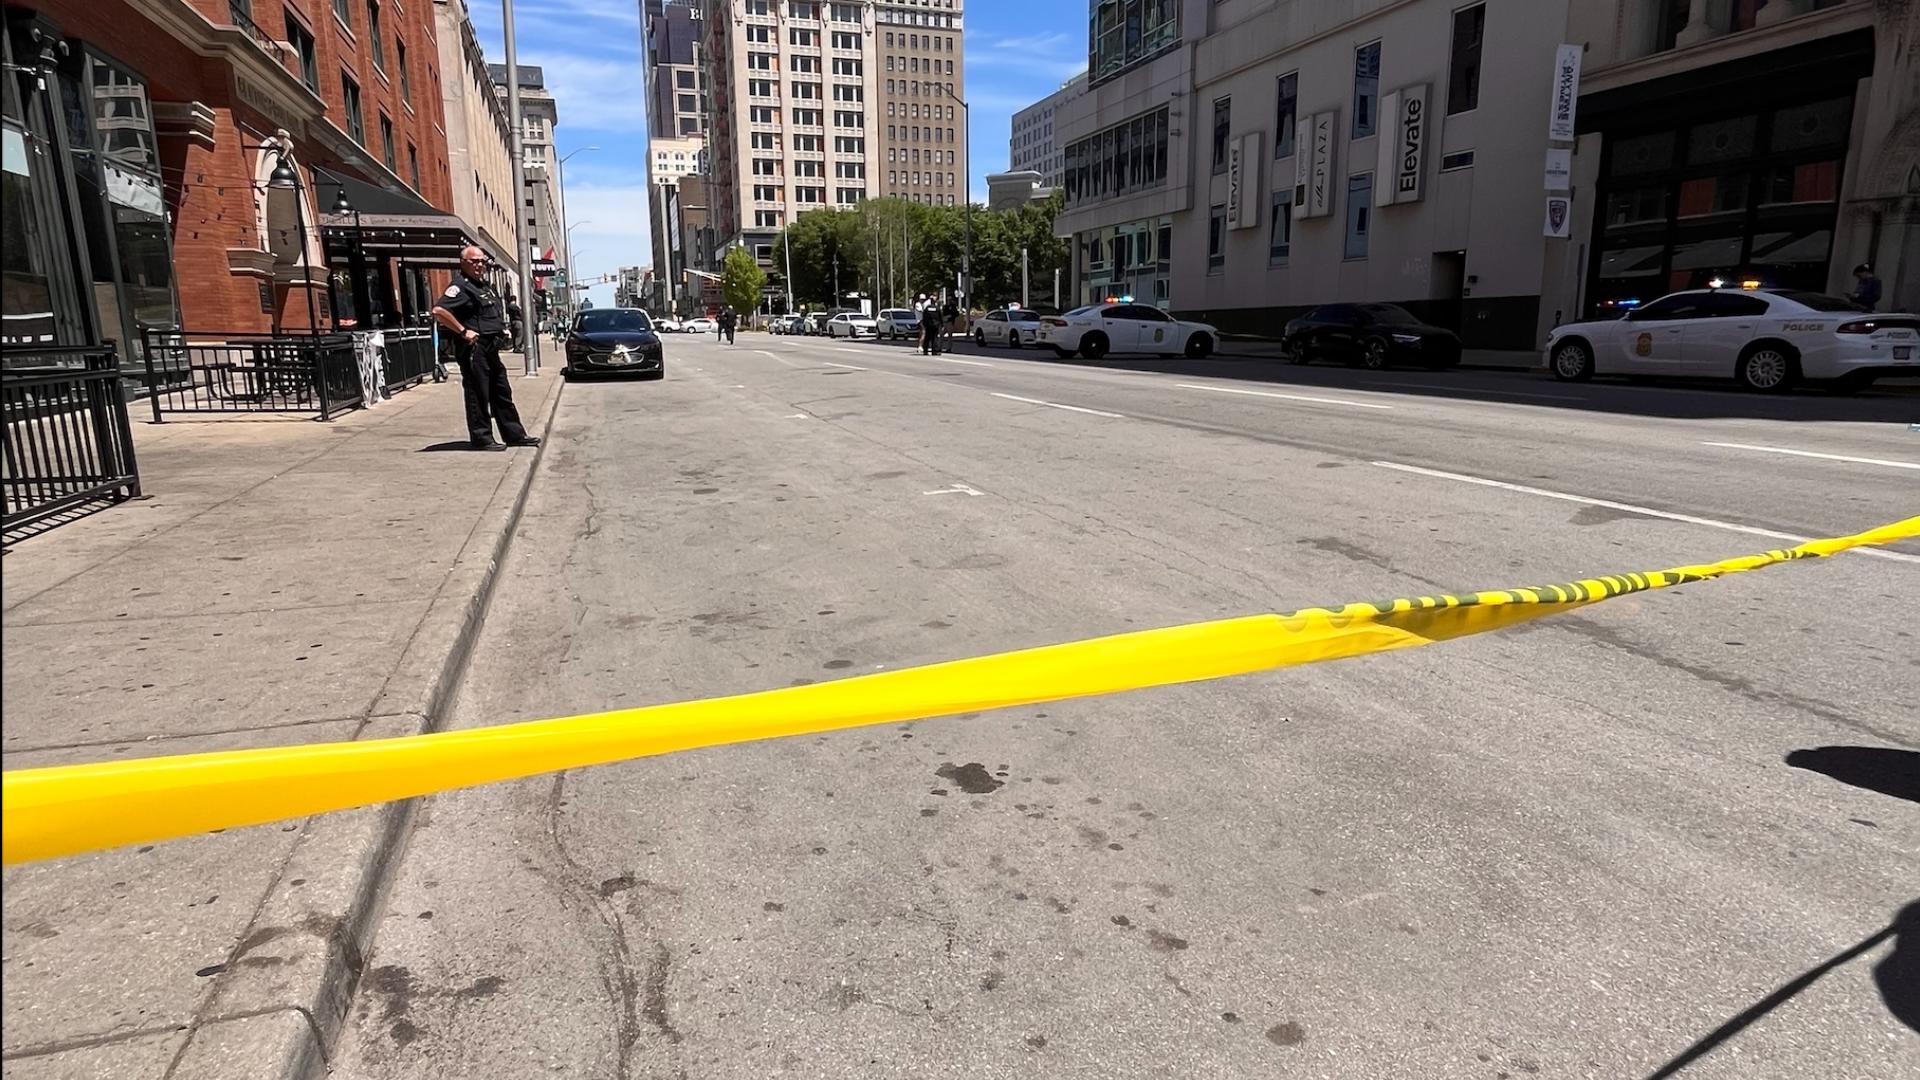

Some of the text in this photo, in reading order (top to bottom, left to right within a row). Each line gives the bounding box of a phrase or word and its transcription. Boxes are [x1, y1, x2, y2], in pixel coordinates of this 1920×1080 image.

[1317, 120, 1328, 177] PLAZA
[1399, 98, 1421, 192] Elevate
[1228, 149, 1238, 223] Elevate
[1782, 323, 1824, 331] POLICE
